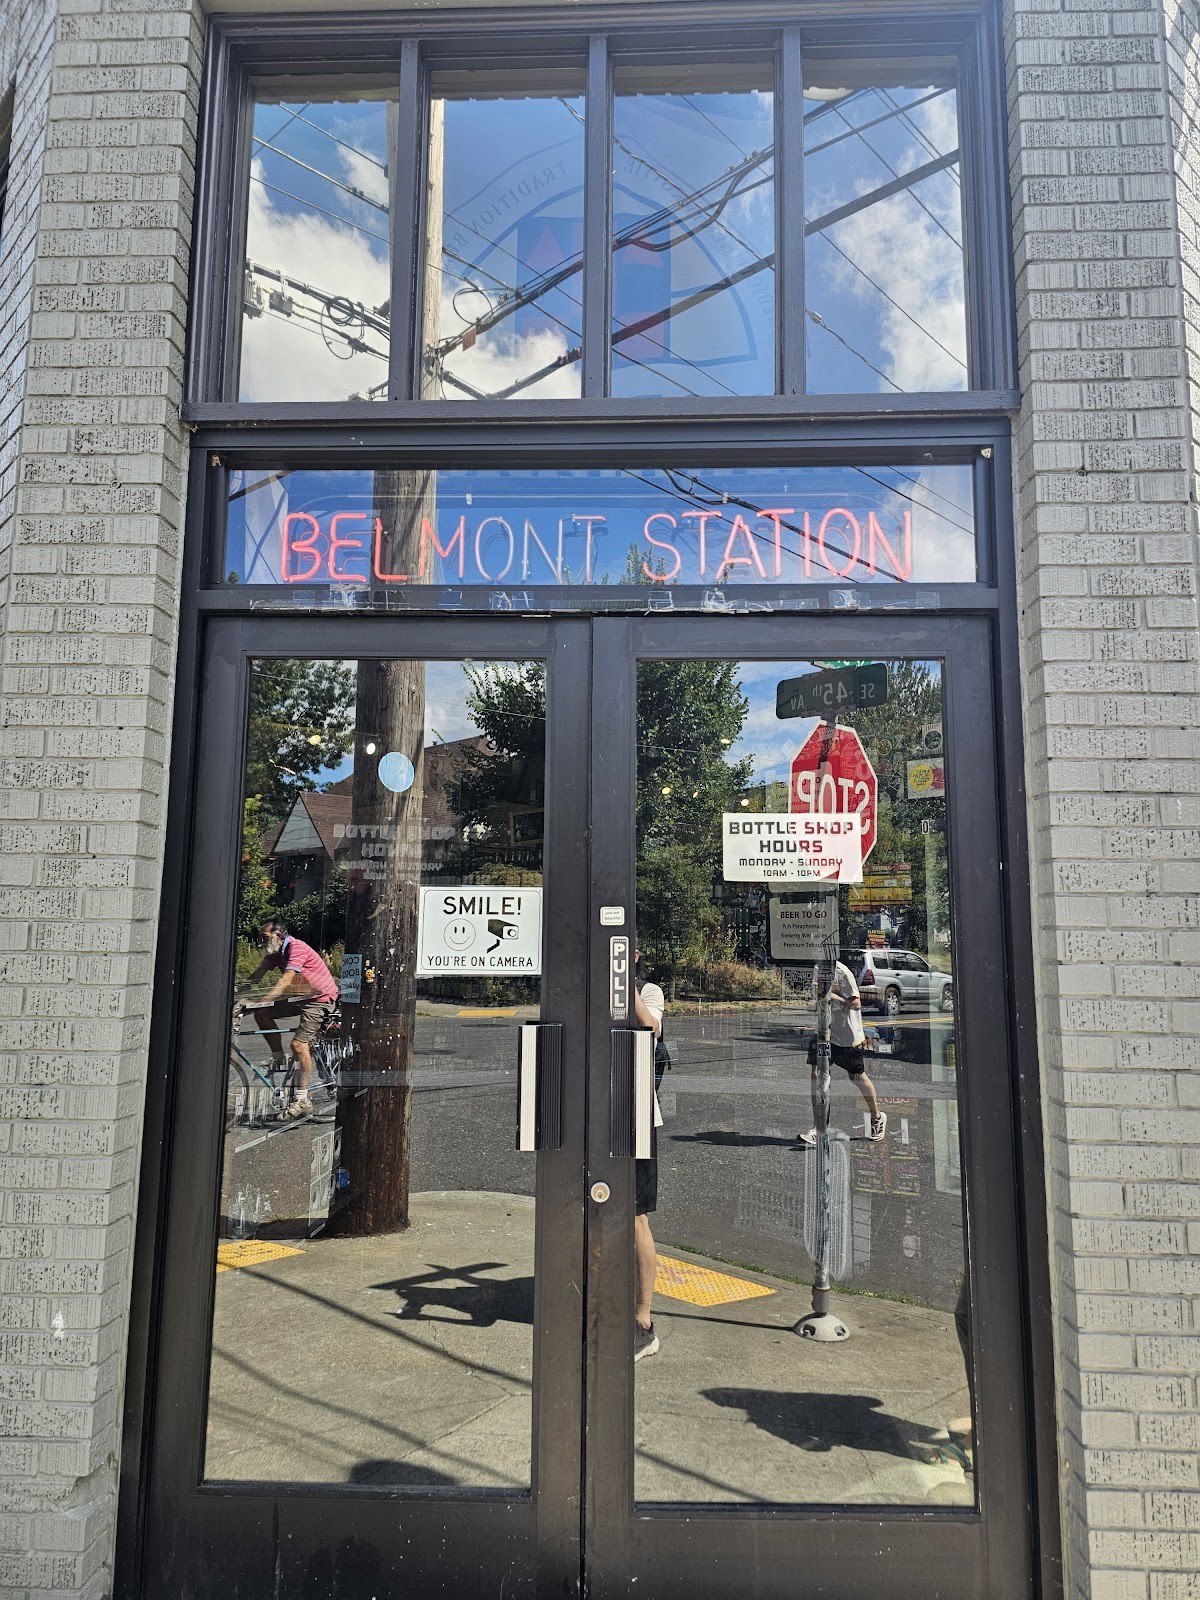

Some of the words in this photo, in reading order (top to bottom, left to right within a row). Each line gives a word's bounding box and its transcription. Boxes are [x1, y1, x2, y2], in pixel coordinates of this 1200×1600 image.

[281, 512, 608, 584] BELMONT
[642, 507, 912, 581] STATION
[729, 821, 797, 835] BOTTLE
[804, 821, 854, 835] SHOP
[759, 839, 823, 853] HOURS
[739, 858, 786, 867] MONDAY
[797, 858, 843, 867] SUNDAY
[763, 869, 787, 877] 10AM
[797, 869, 821, 877] 10PM
[442, 896, 522, 915] SMILE!
[780, 911, 800, 919] BEER
[802, 911, 812, 919] TO
[814, 910, 827, 919] GO
[427, 955, 467, 967] YOU'RE
[470, 956, 485, 967] ON
[489, 956, 533, 967] CAMERA
[613, 943, 626, 1007] PULL
